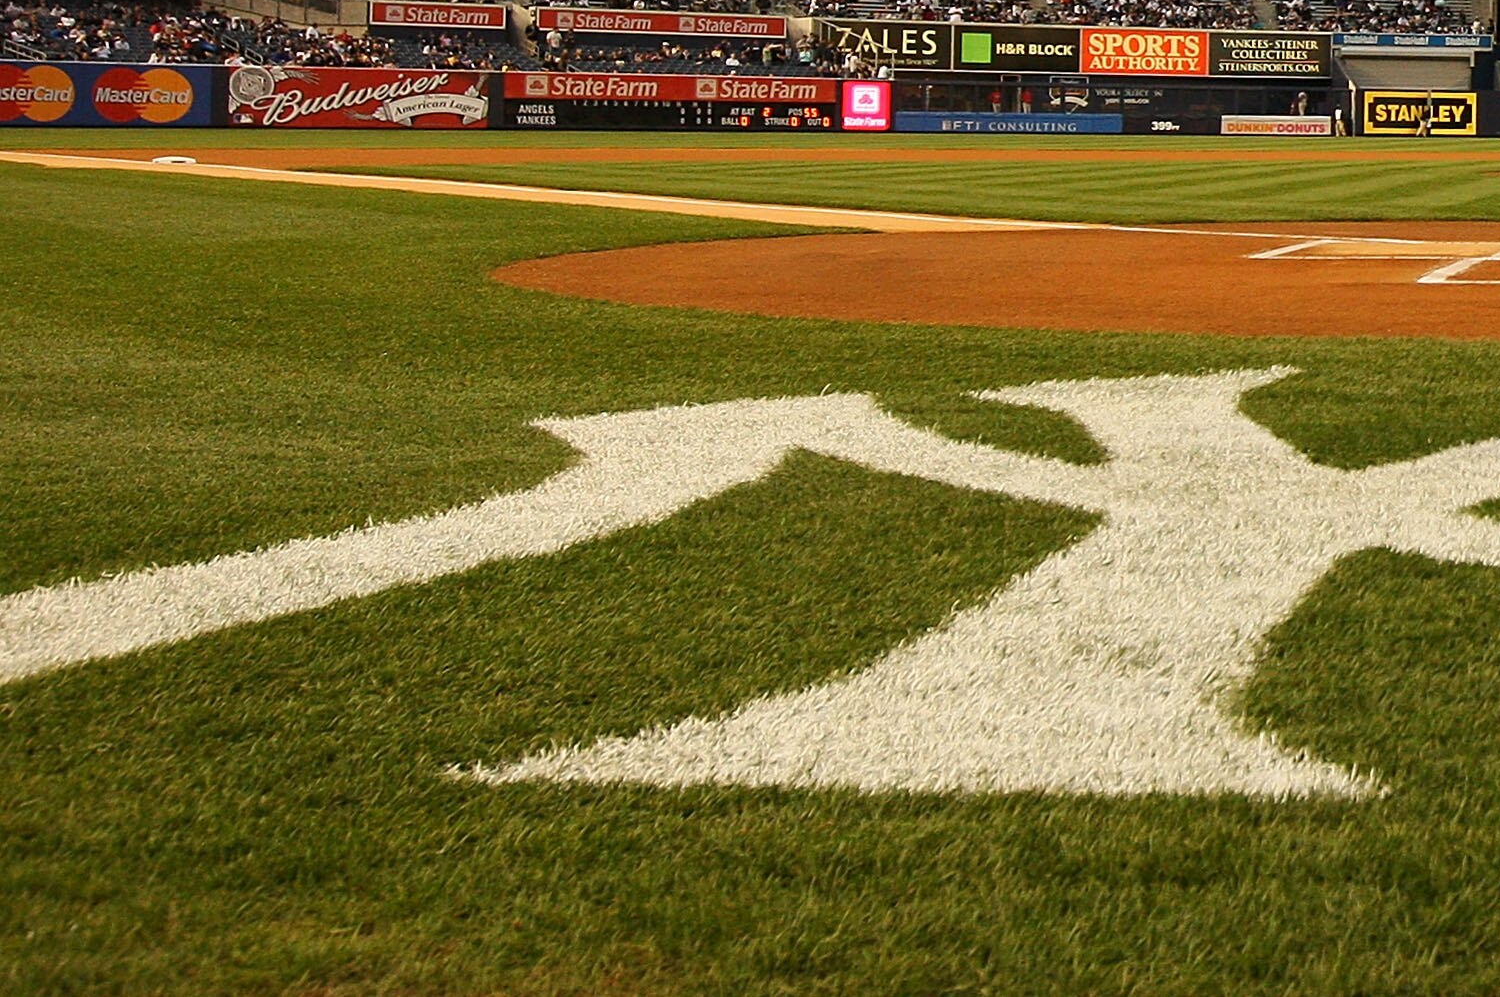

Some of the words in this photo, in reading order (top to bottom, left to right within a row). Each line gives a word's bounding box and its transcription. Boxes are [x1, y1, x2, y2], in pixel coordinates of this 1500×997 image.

[836, 28, 937, 55] ZALES
[1088, 33, 1199, 57] SPORTS
[996, 43, 1026, 55] H&R
[1028, 44, 1073, 56] BLOCK
[1232, 50, 1308, 60] COLLECTIBLES
[1089, 57, 1199, 71] AUTHORITY
[1218, 62, 1320, 73] STEINERSPORTS.COM
[95, 87, 190, 104] MasterCard
[251, 73, 449, 126] Budweiser
[395, 100, 447, 115] American
[447, 98, 480, 114] Lager
[518, 105, 555, 115] ANGELS
[516, 115, 556, 125] YANKEES
[721, 117, 740, 126] BALL
[765, 118, 790, 126] STRIKE
[989, 122, 1077, 132] CONSULTING
[1227, 123, 1277, 133] DUNKIN'
[1277, 124, 1325, 133] DONUTS
